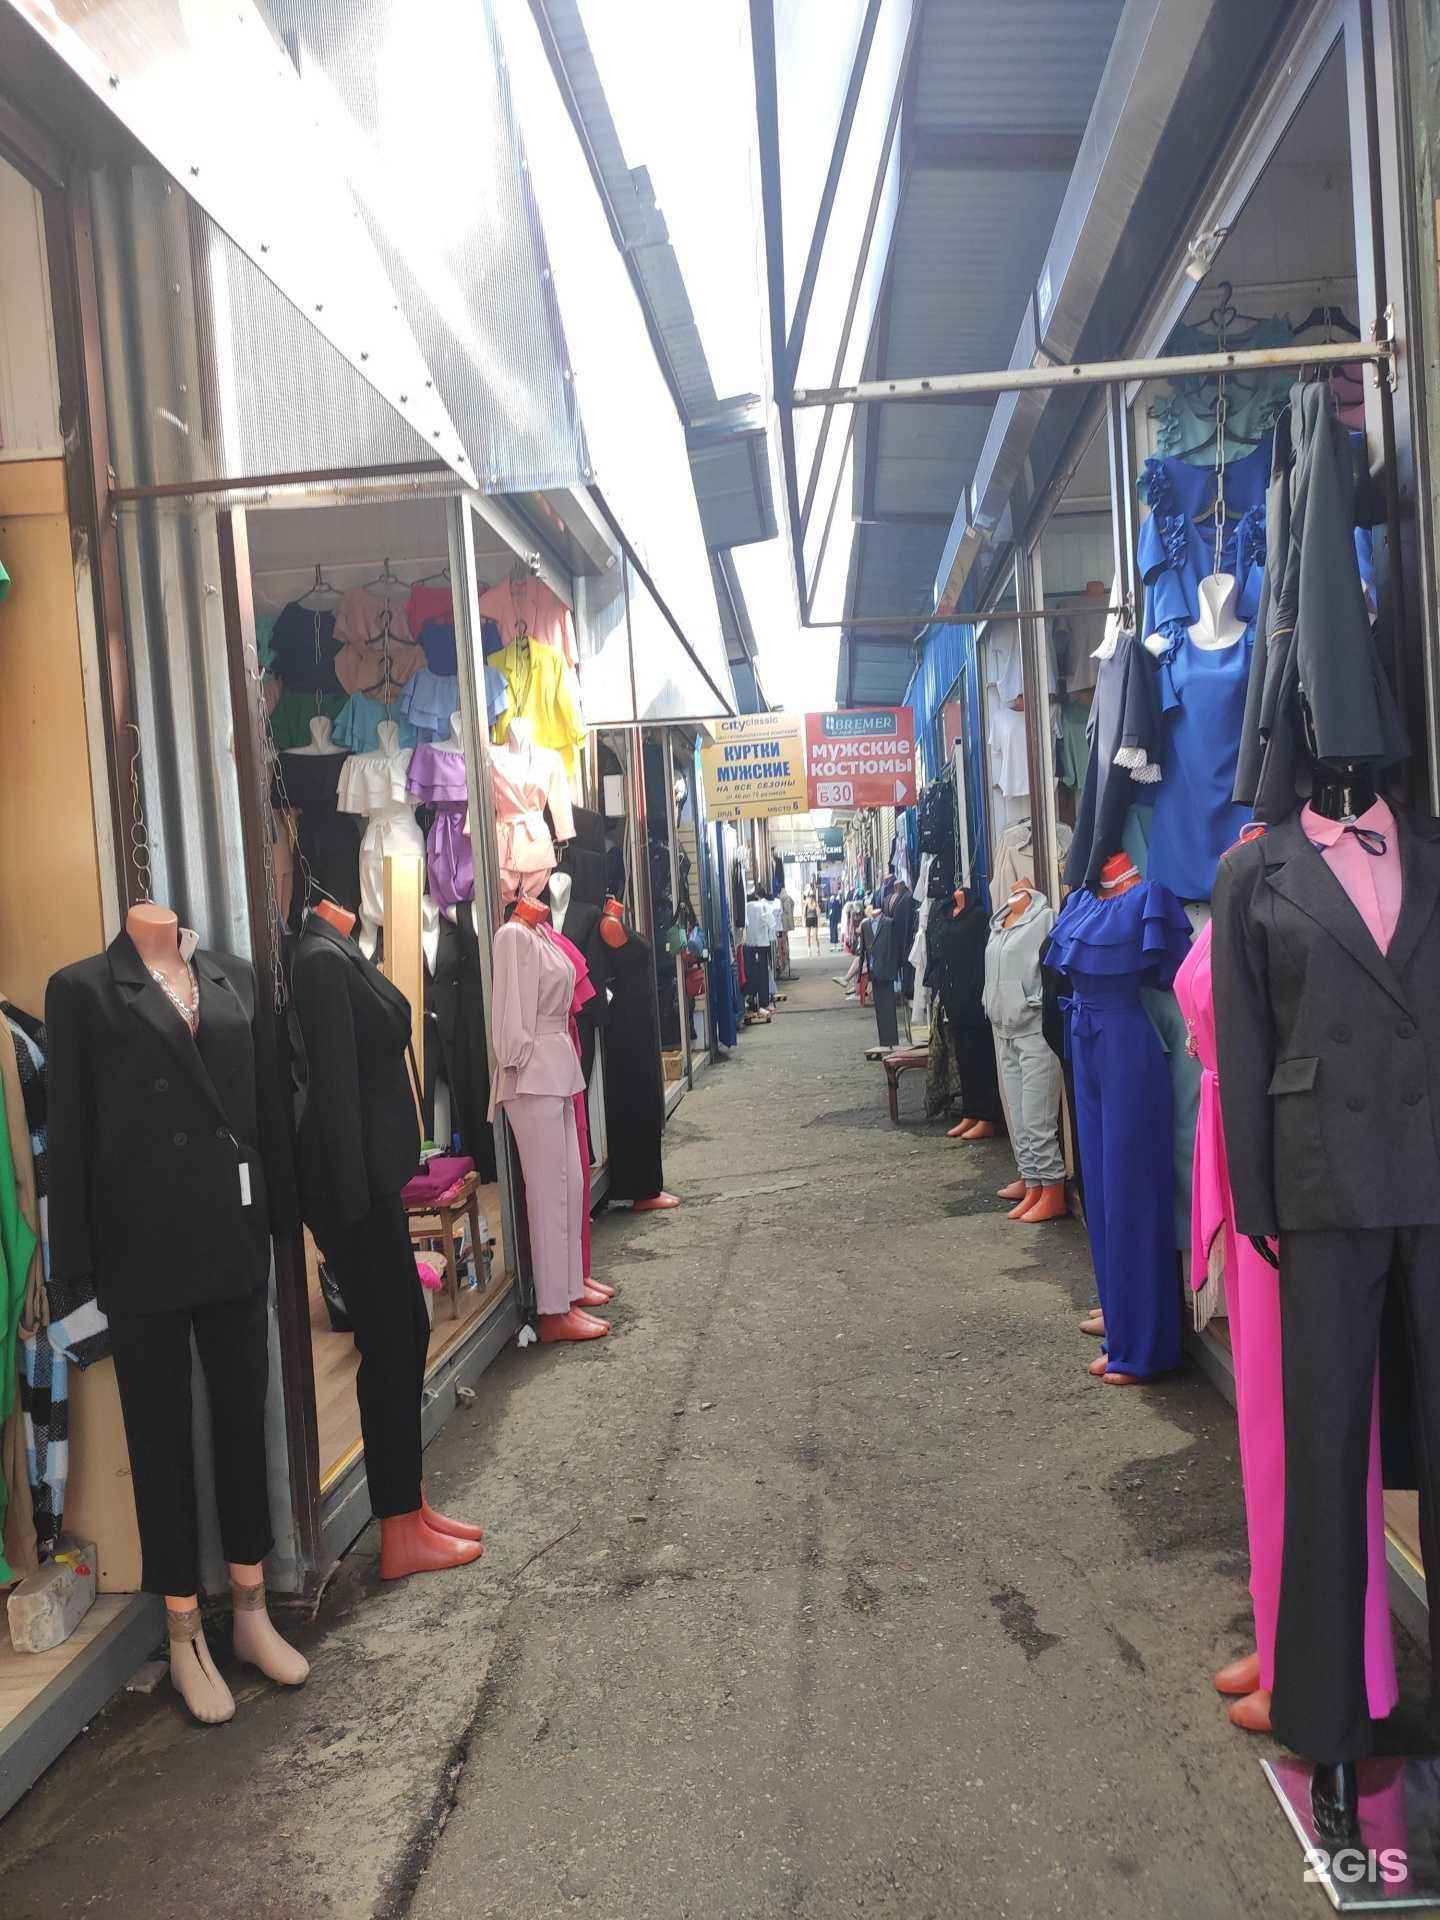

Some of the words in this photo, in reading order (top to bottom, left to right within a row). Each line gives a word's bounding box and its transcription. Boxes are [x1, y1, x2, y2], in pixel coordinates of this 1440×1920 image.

[724, 742, 780, 761] КУРТКИ
[717, 762, 790, 782] МУЖСКИЕ
[716, 784, 729, 793] НА
[734, 783, 752, 792] ВСЕ
[757, 779, 795, 790] СЕЗОНЫ
